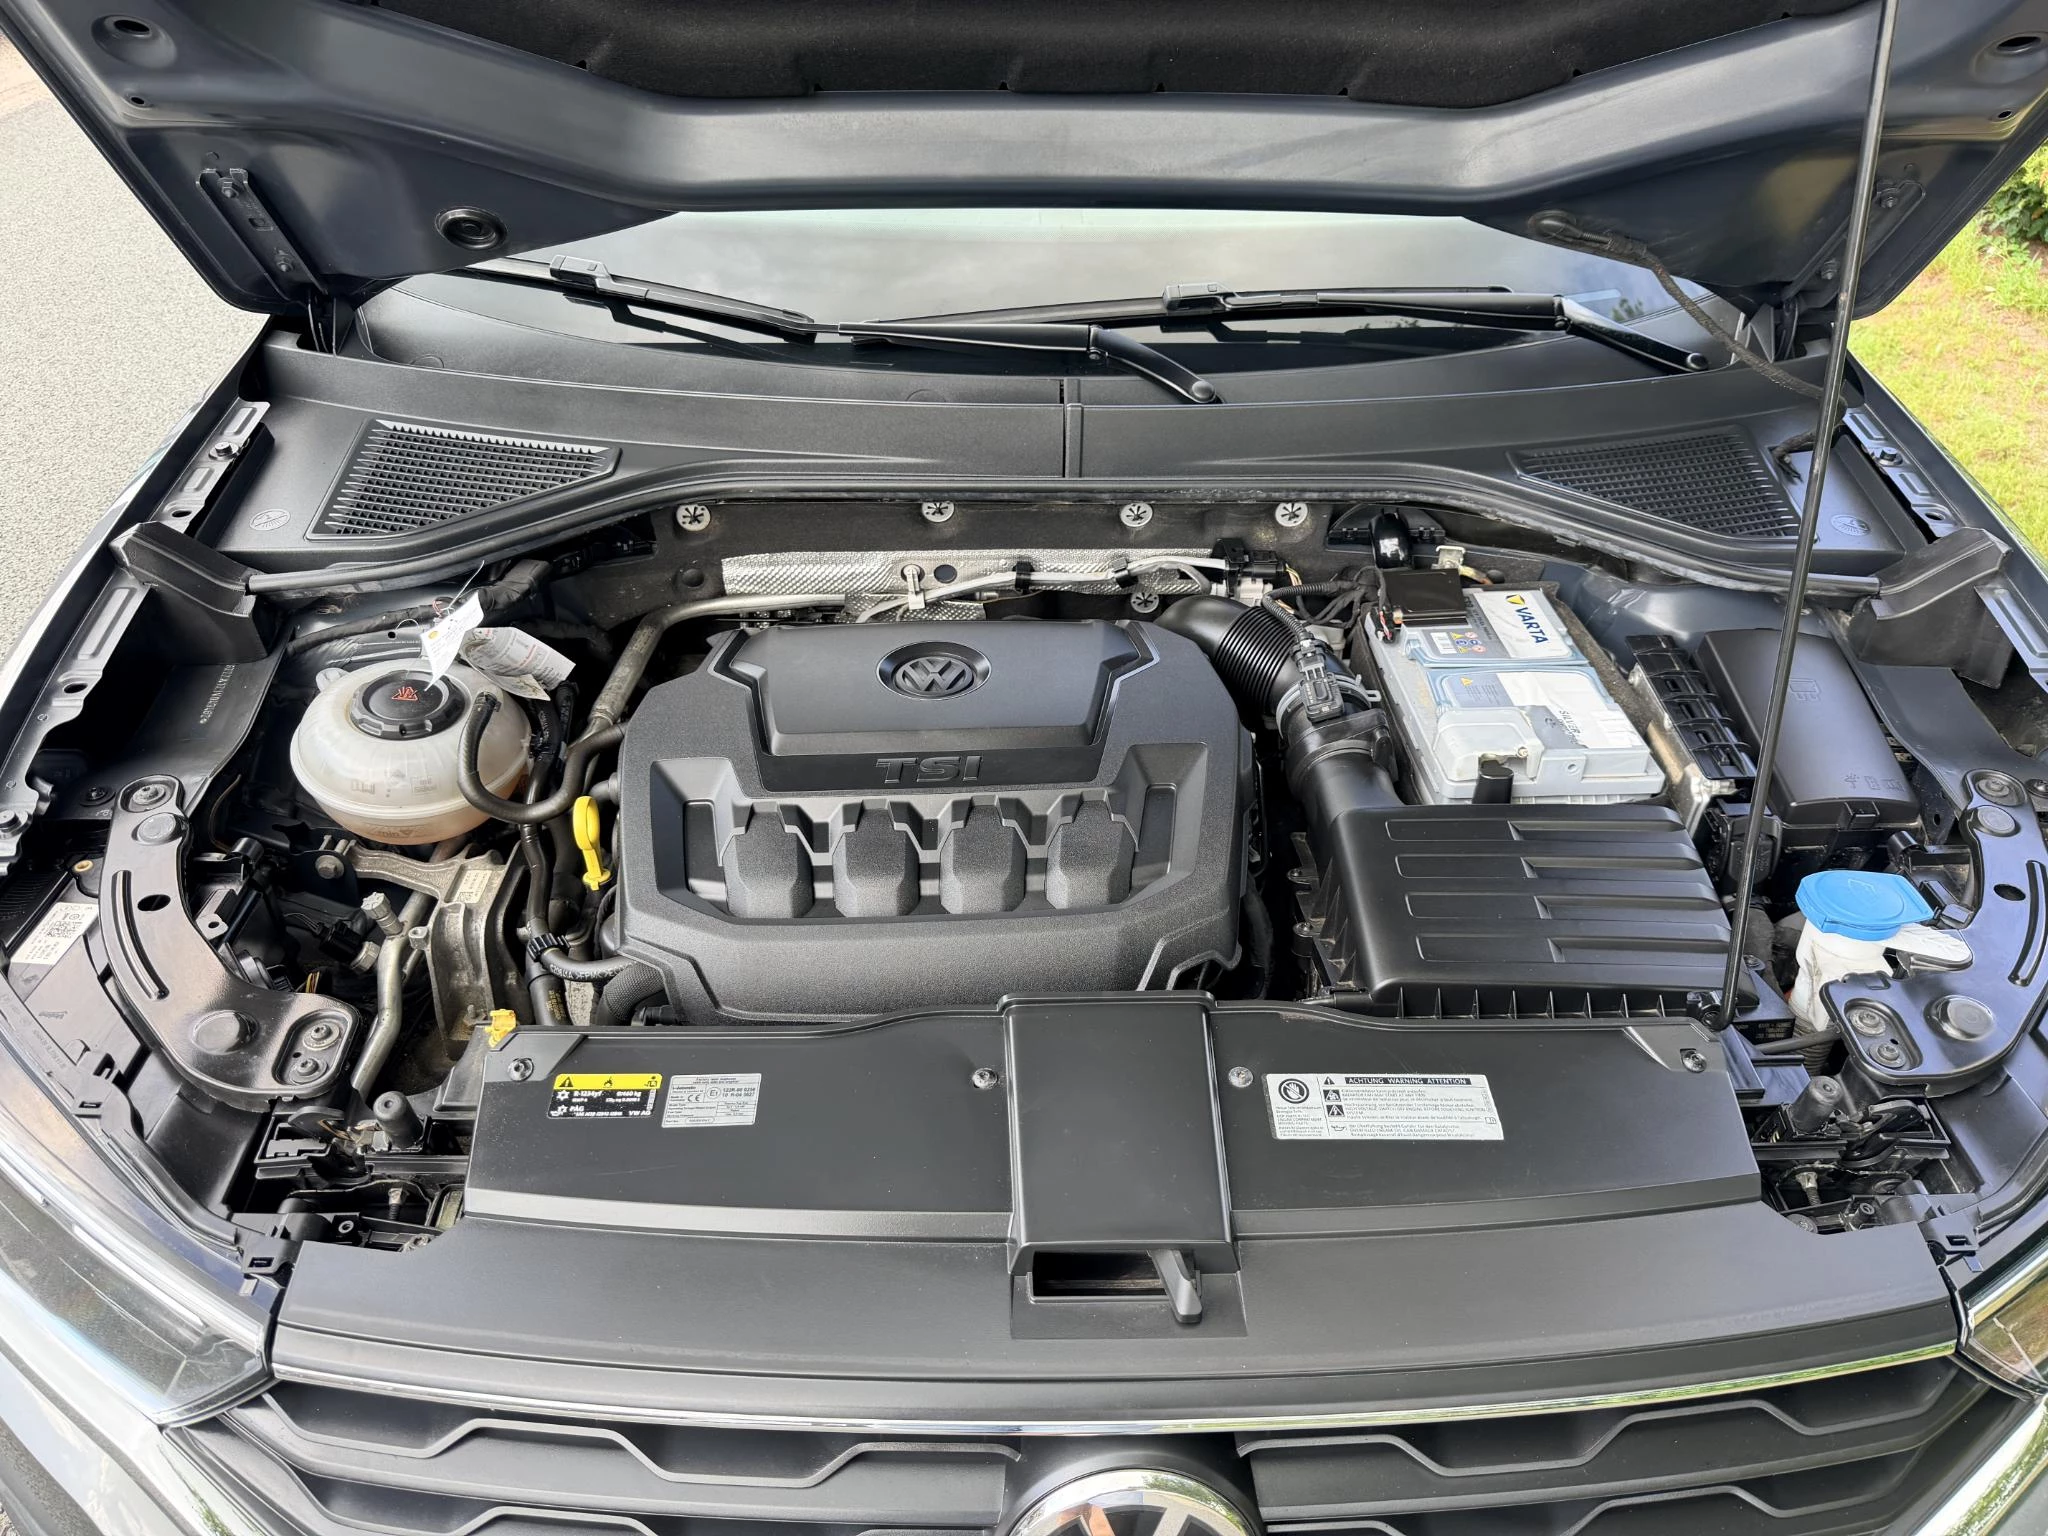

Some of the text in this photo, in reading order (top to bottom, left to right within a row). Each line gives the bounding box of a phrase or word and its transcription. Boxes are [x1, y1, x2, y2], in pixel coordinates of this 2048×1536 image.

[1514, 606, 1549, 644] VARTA
[897, 656, 974, 696] VW
[1559, 709, 1581, 735] SILVER
[875, 755, 983, 784] TSI
